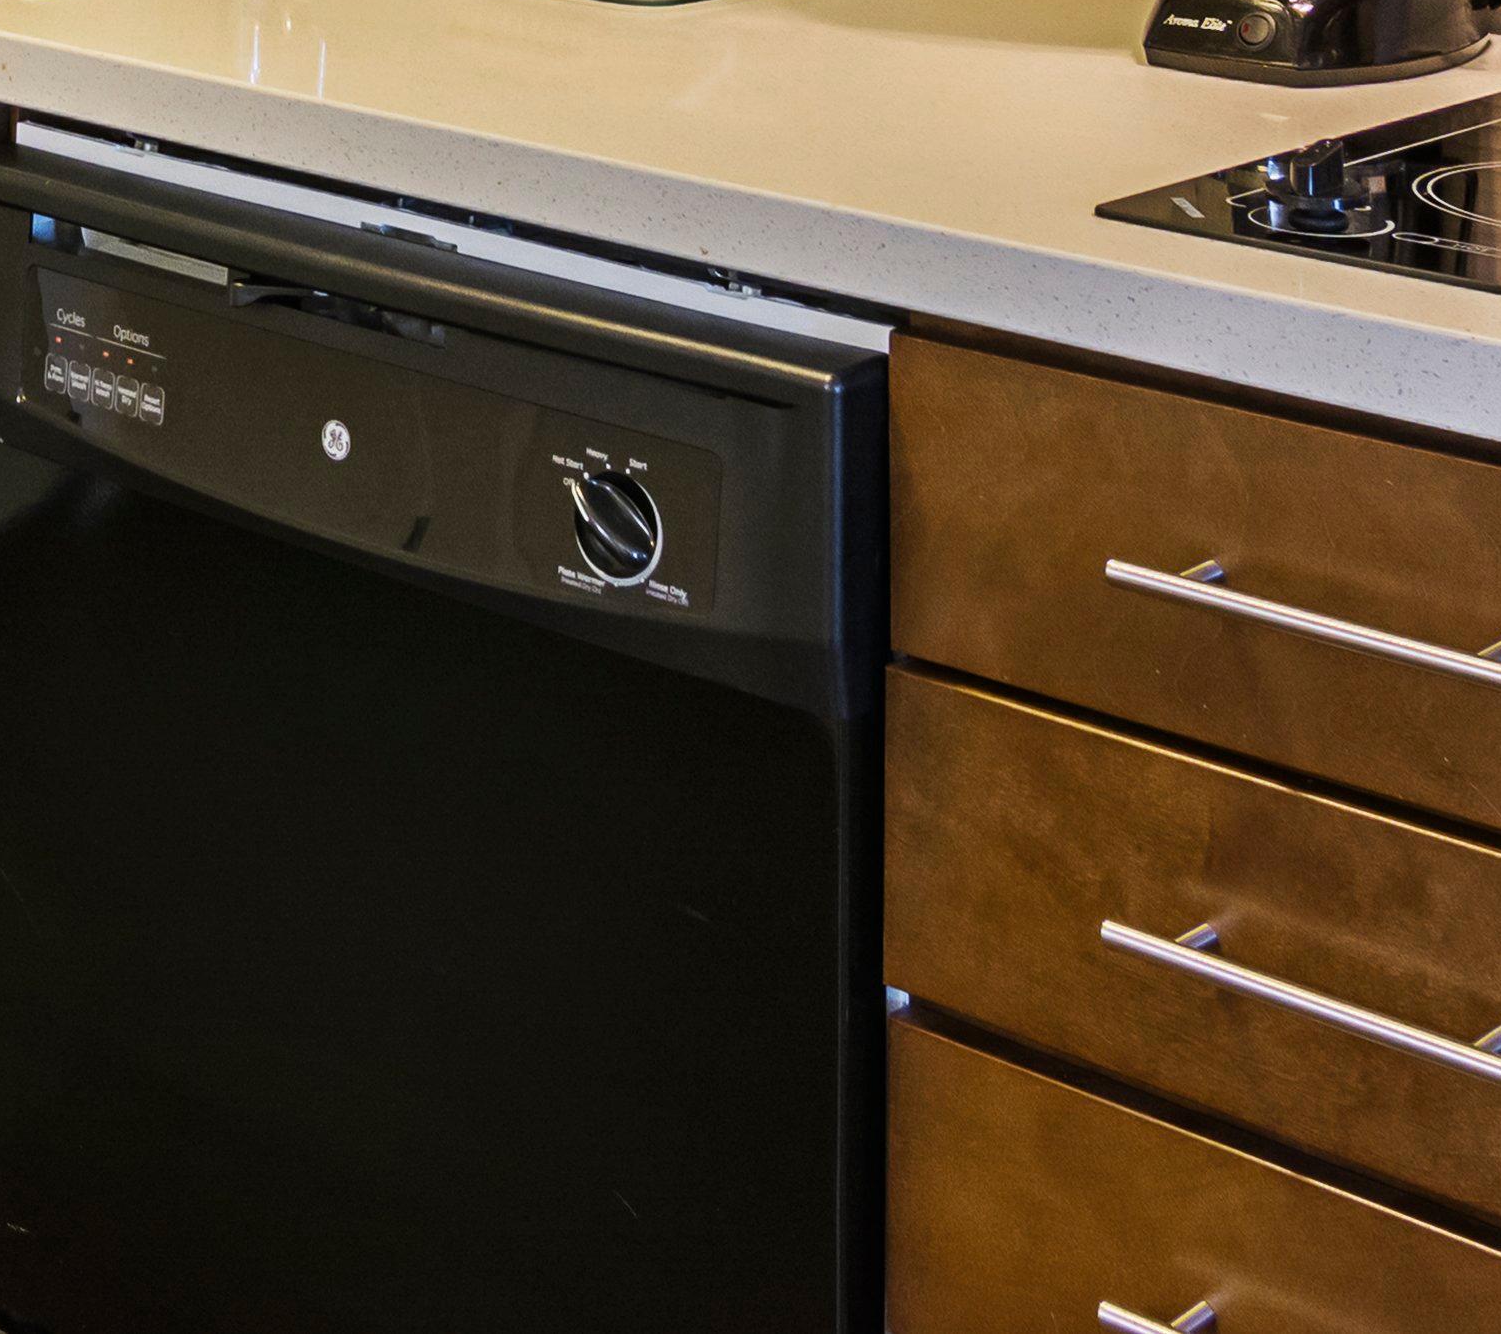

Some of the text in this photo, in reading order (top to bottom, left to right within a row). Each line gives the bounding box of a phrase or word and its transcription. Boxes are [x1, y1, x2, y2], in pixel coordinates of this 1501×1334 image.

[56, 308, 150, 347] Cycles Options
[629, 458, 648, 471] Start
